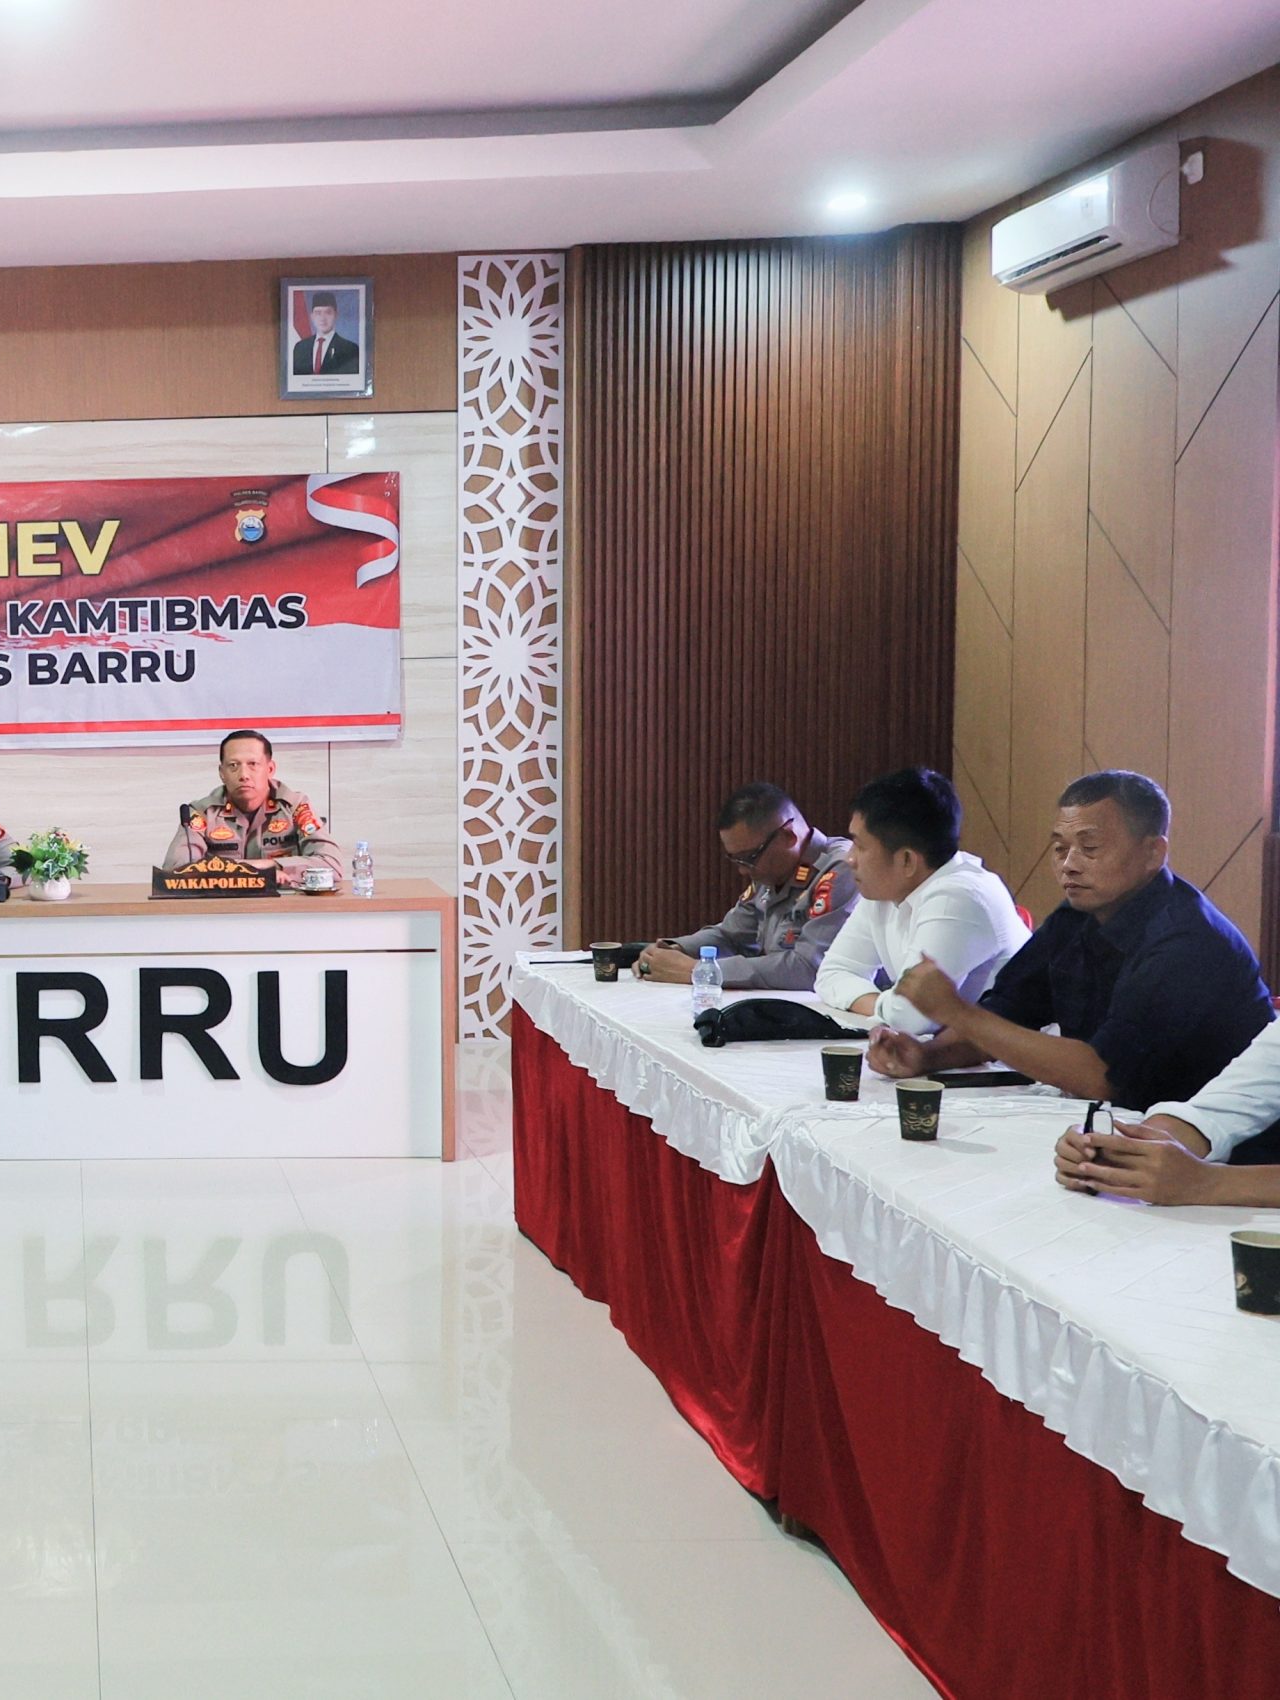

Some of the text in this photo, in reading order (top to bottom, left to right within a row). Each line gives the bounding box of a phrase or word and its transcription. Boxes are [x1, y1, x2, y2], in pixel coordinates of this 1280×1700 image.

[10, 595, 306, 638] KAMTIBMAS
[28, 649, 196, 685] BARRU
[165, 877, 265, 890] WAKAPOLRES
